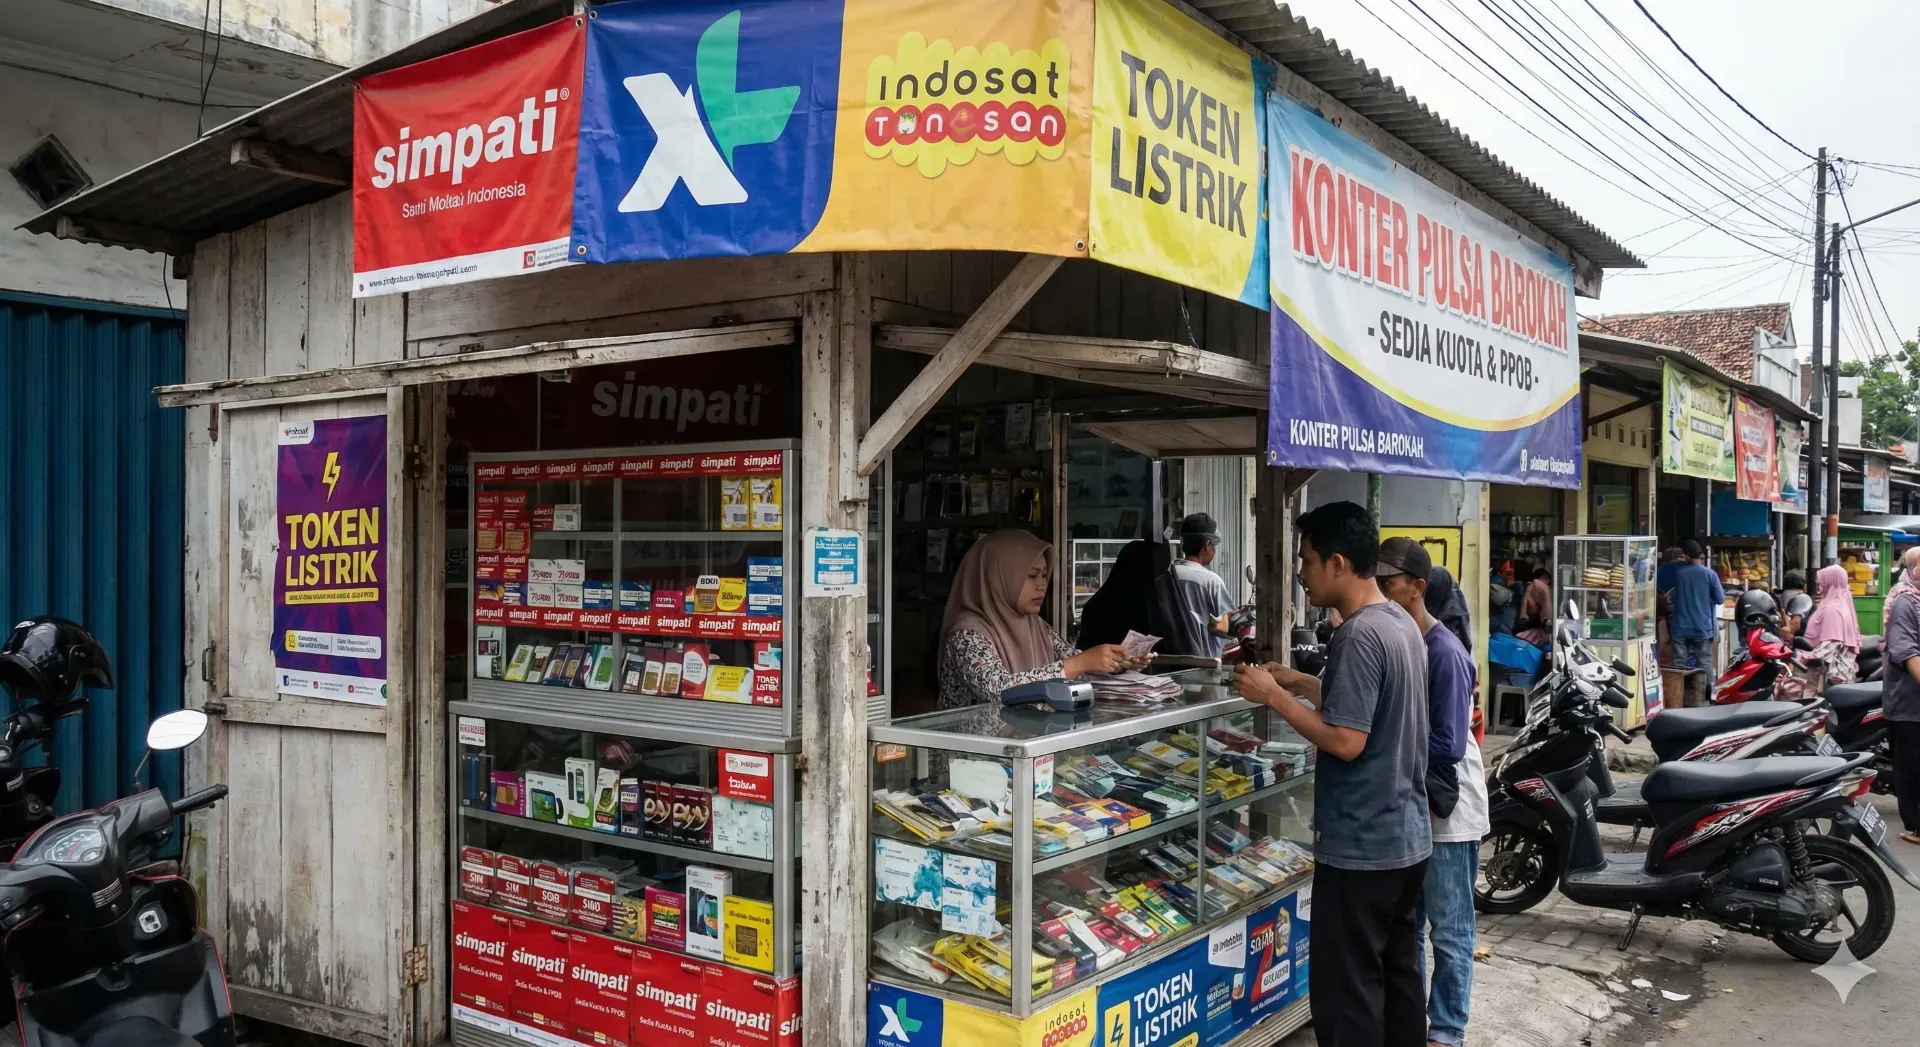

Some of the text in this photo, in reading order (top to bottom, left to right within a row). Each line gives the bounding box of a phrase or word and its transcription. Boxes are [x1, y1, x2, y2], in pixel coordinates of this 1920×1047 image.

[617, 9, 800, 213] XL
[1121, 50, 1241, 166] TOKEN
[371, 88, 558, 189] simpati
[466, 180, 526, 205] Indonesia
[1111, 126, 1248, 238] LISTRIK
[1290, 148, 1569, 352] KONTER PULSA BAROKAH
[1379, 310, 1432, 365] SEDIA
[1436, 329, 1483, 380] KUOTA
[1487, 344, 1497, 382] &
[591, 371, 763, 432] simpati
[1289, 419, 1424, 458] KONTER PULSA BAROKAH
[285, 506, 379, 551] TOKEN
[285, 549, 379, 587] LISTRIK
[455, 932, 506, 958] simpati
[512, 947, 566, 975] simpati
[572, 964, 629, 993] simpati
[636, 981, 696, 1012] simpati
[1134, 968, 1193, 1020] TOKEN
[706, 999, 770, 1032] simpati
[1134, 994, 1198, 1047] LISTRIK
